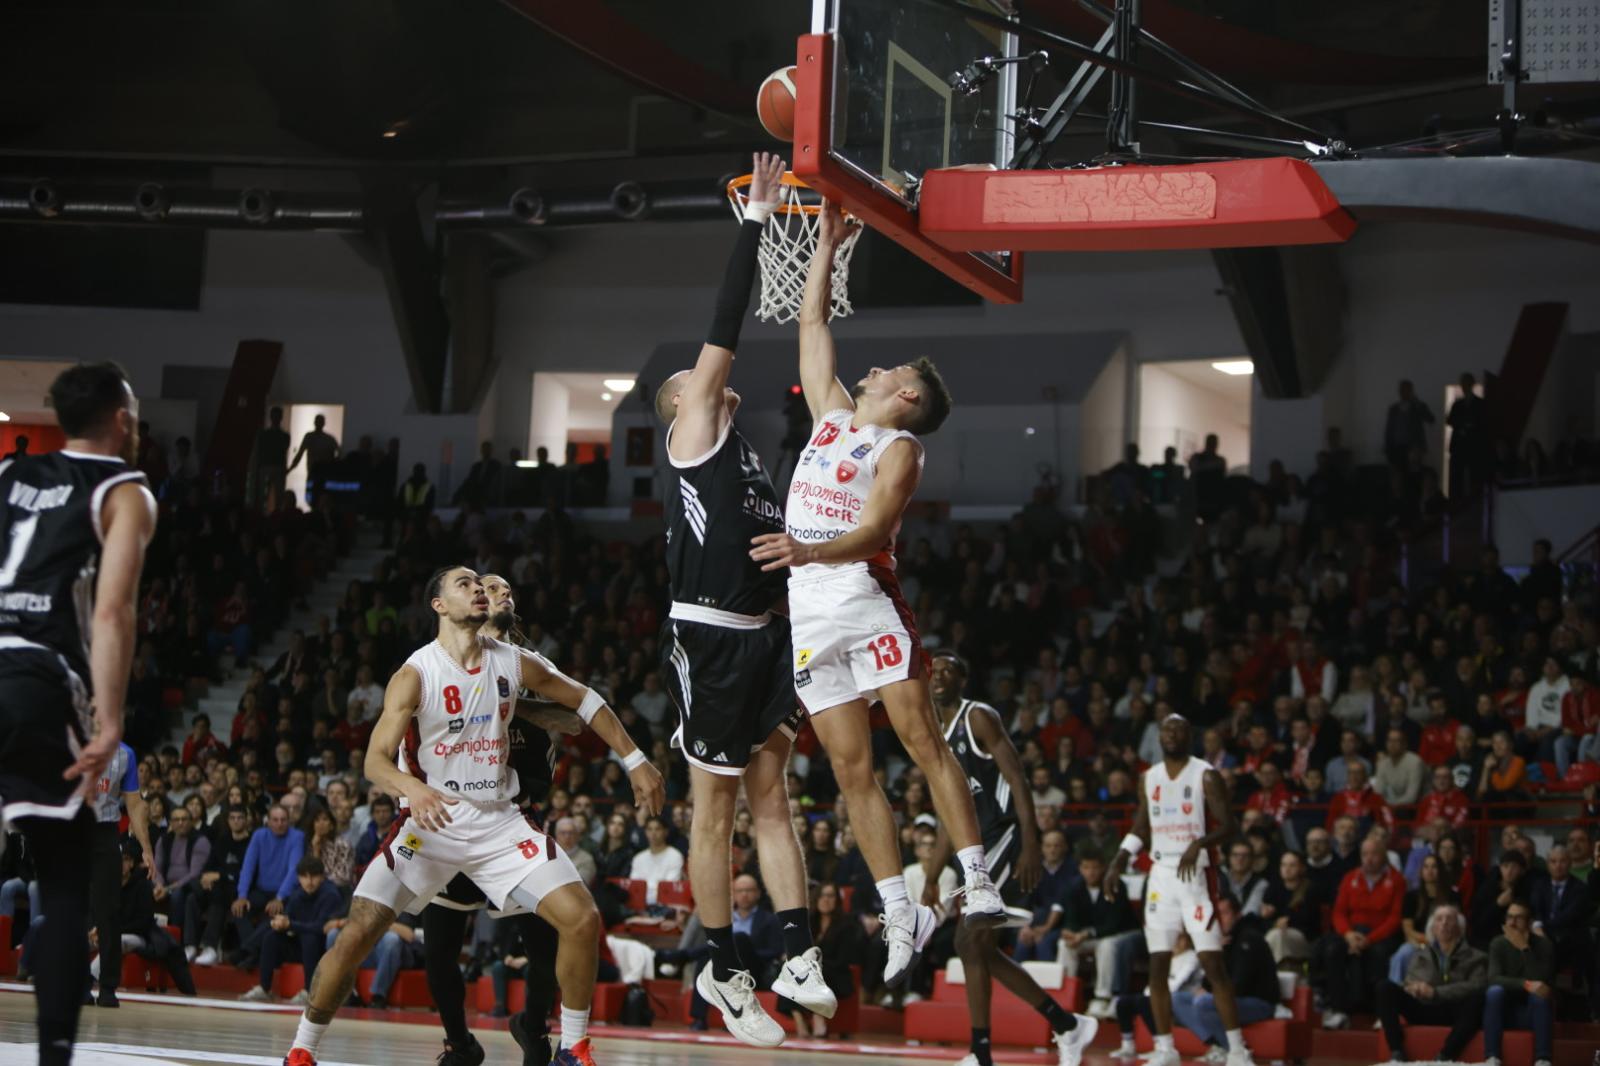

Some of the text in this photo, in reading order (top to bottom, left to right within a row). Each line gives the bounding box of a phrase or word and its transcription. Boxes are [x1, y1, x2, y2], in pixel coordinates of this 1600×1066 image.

[867, 633, 903, 672] 13
[443, 685, 463, 715] 8
[1151, 784, 1162, 802] 4
[517, 838, 541, 860] 8
